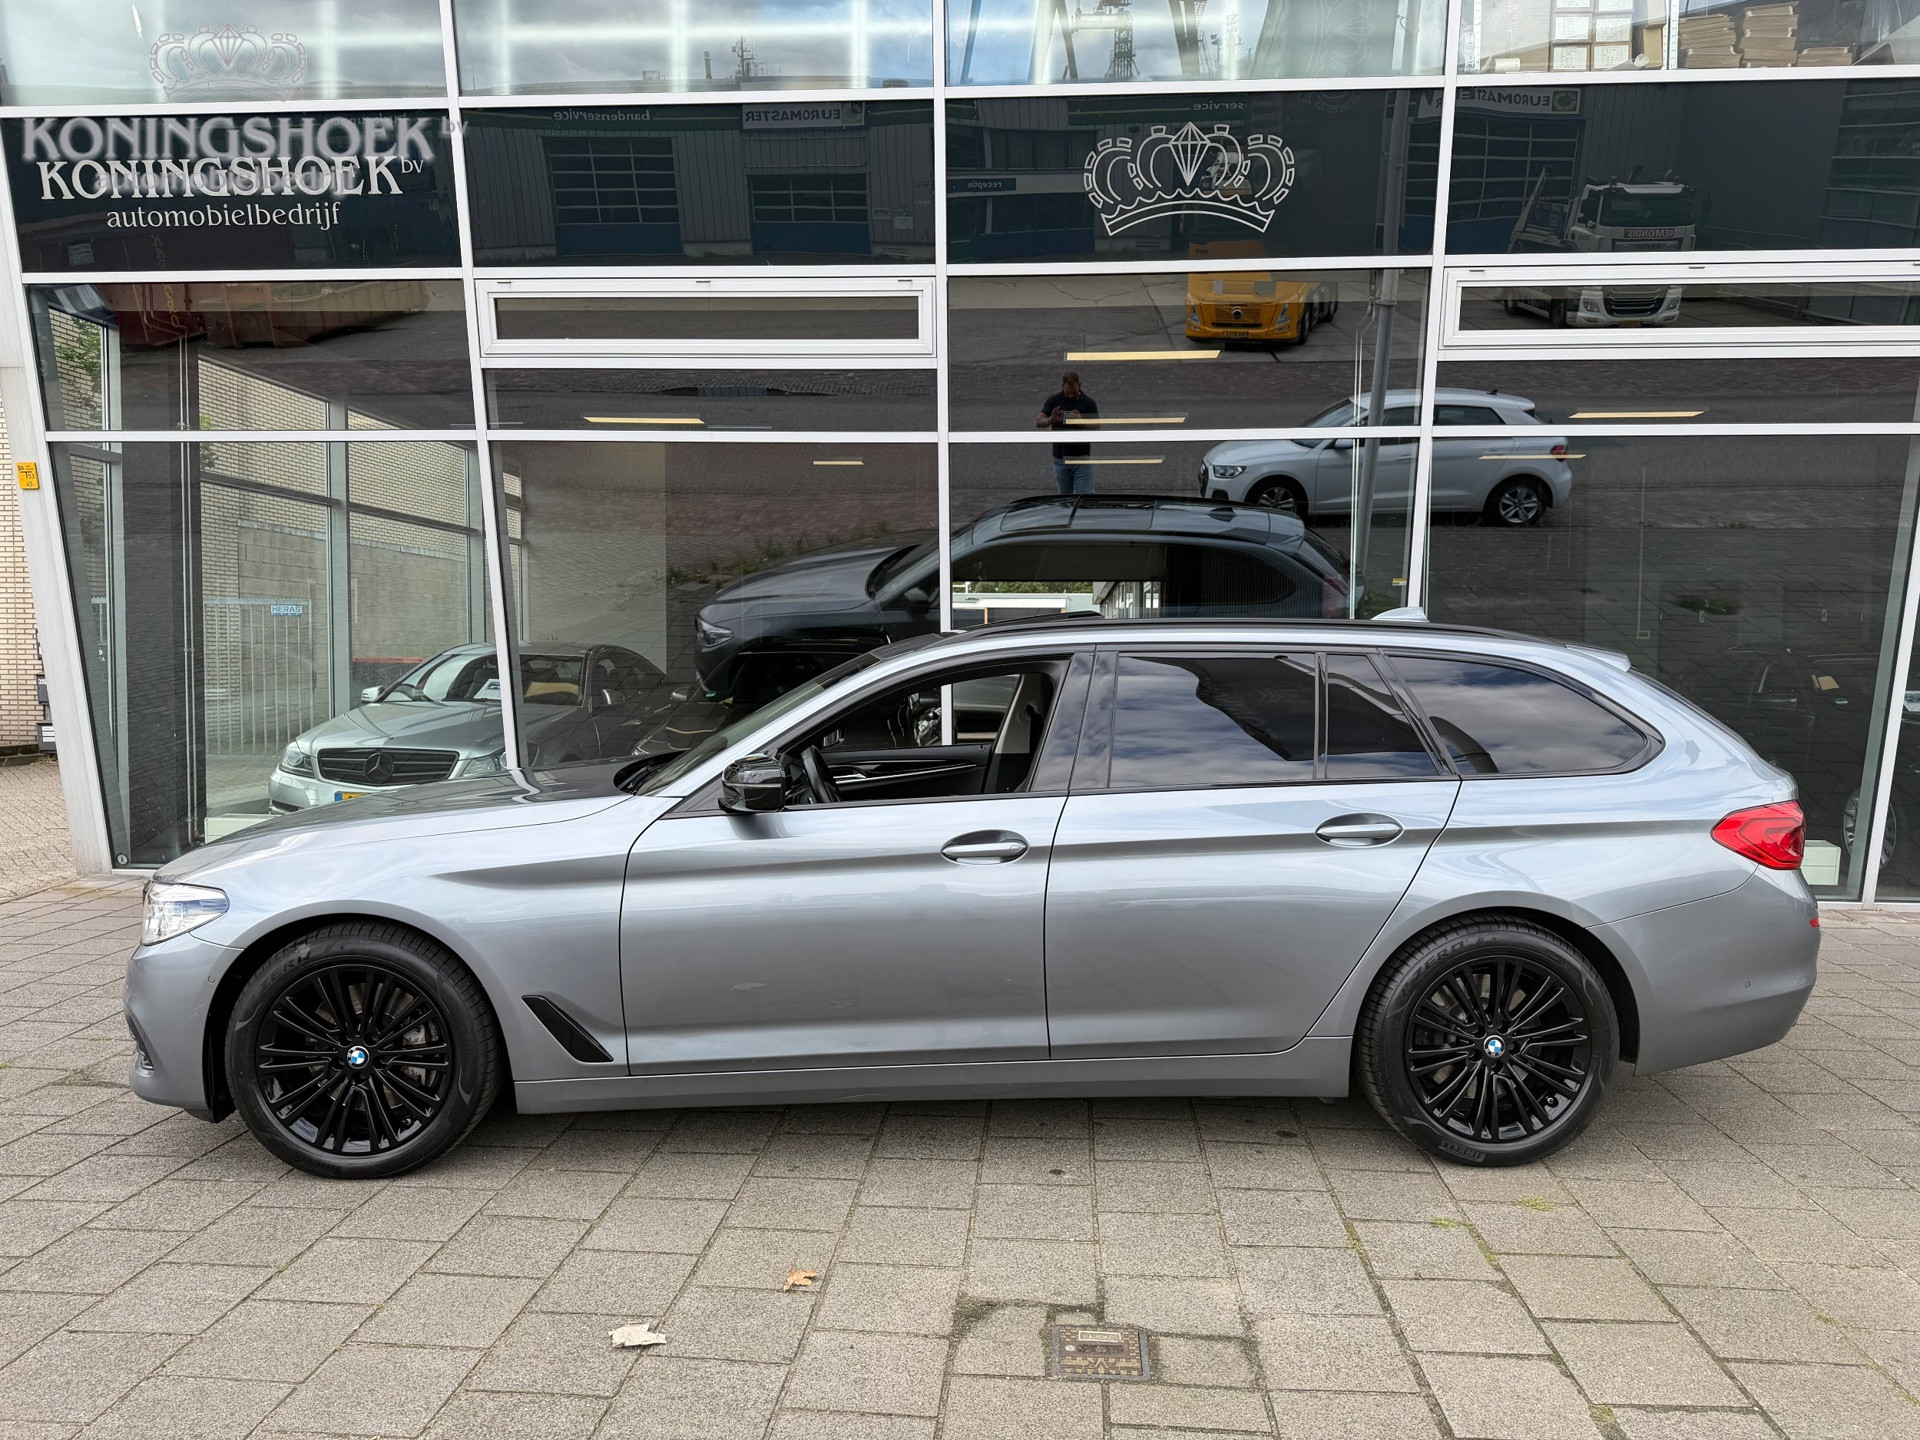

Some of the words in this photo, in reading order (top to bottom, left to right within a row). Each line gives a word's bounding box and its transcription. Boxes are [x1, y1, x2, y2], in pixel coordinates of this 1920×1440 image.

[36, 155, 403, 199] KONINGSHOEK
[401, 158, 424, 173] bv
[106, 201, 341, 231] automobielbedrijf
[272, 604, 302, 613] HERAS
